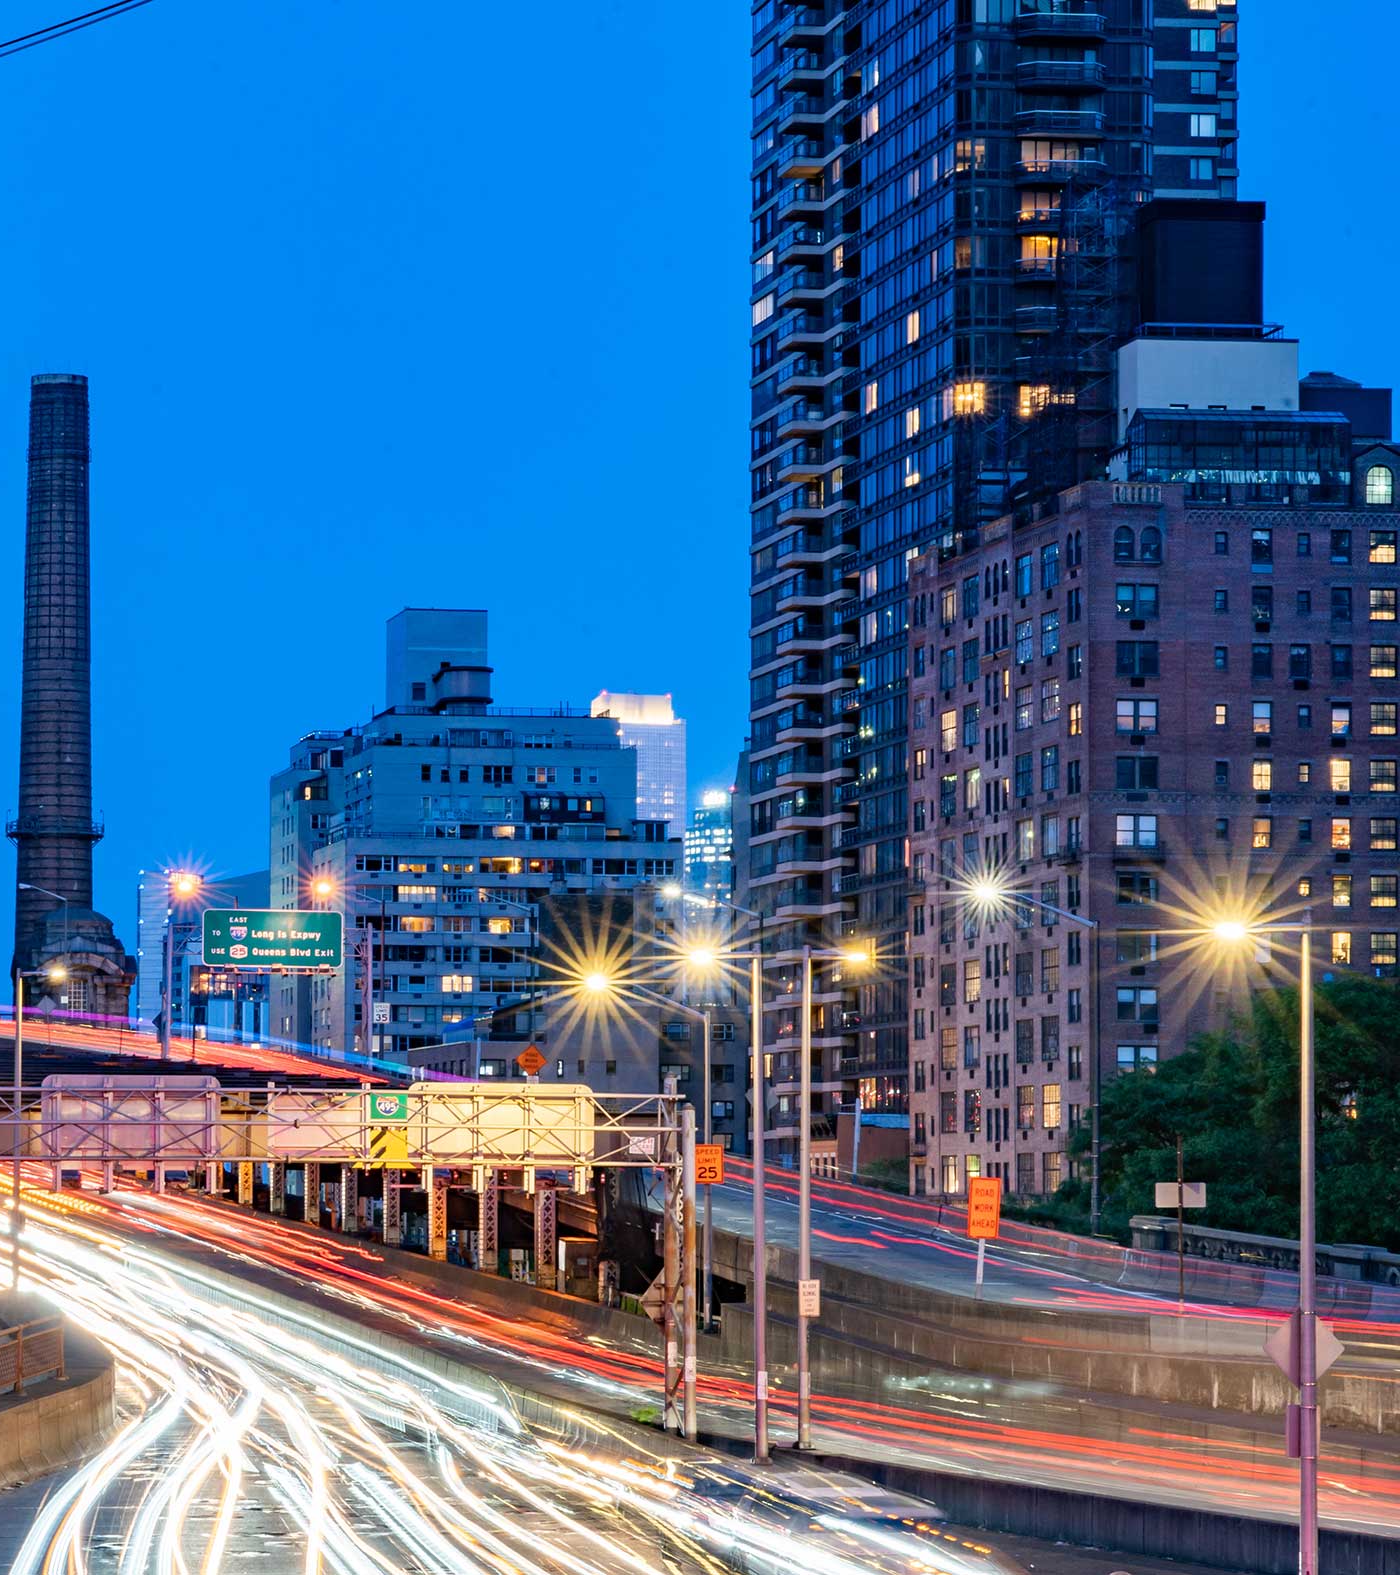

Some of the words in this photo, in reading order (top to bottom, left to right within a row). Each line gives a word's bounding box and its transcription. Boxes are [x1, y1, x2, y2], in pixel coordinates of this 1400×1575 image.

[251, 930, 274, 940] Long
[278, 930, 287, 938] Is
[290, 931, 321, 941] Expwy
[231, 948, 246, 956] 25
[252, 948, 286, 956] Queens
[290, 948, 311, 956] Blvd
[376, 1014, 388, 1022] 35
[380, 1102, 396, 1112] 495
[698, 1167, 717, 1178] 25
[975, 1188, 994, 1197] ROAD
[975, 1204, 993, 1212] WORK
[972, 1219, 995, 1228] AHEAD
